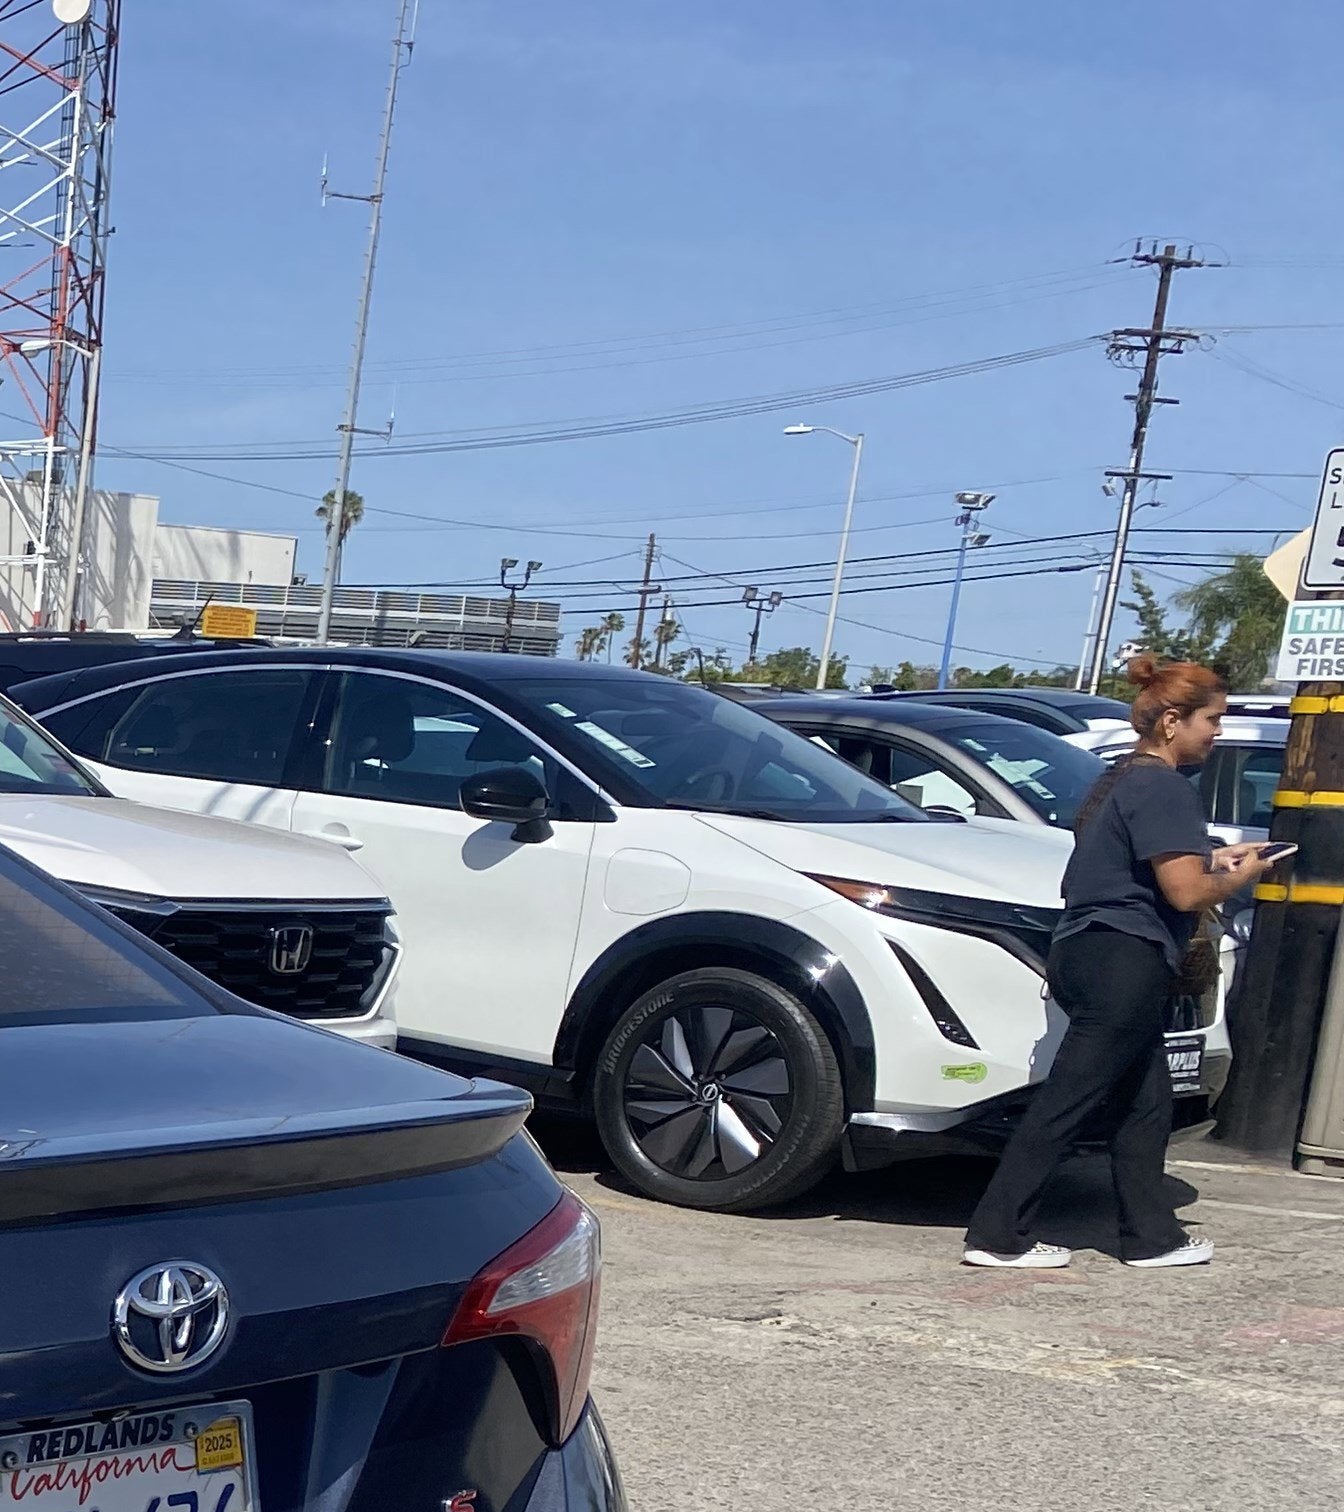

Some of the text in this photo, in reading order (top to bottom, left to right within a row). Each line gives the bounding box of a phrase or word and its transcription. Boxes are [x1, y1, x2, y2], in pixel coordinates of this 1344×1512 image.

[1294, 608, 1344, 632] THI
[27, 1414, 173, 1464] REDLANDS
[204, 1433, 232, 1453] 2025
[11, 1447, 197, 1505] California
